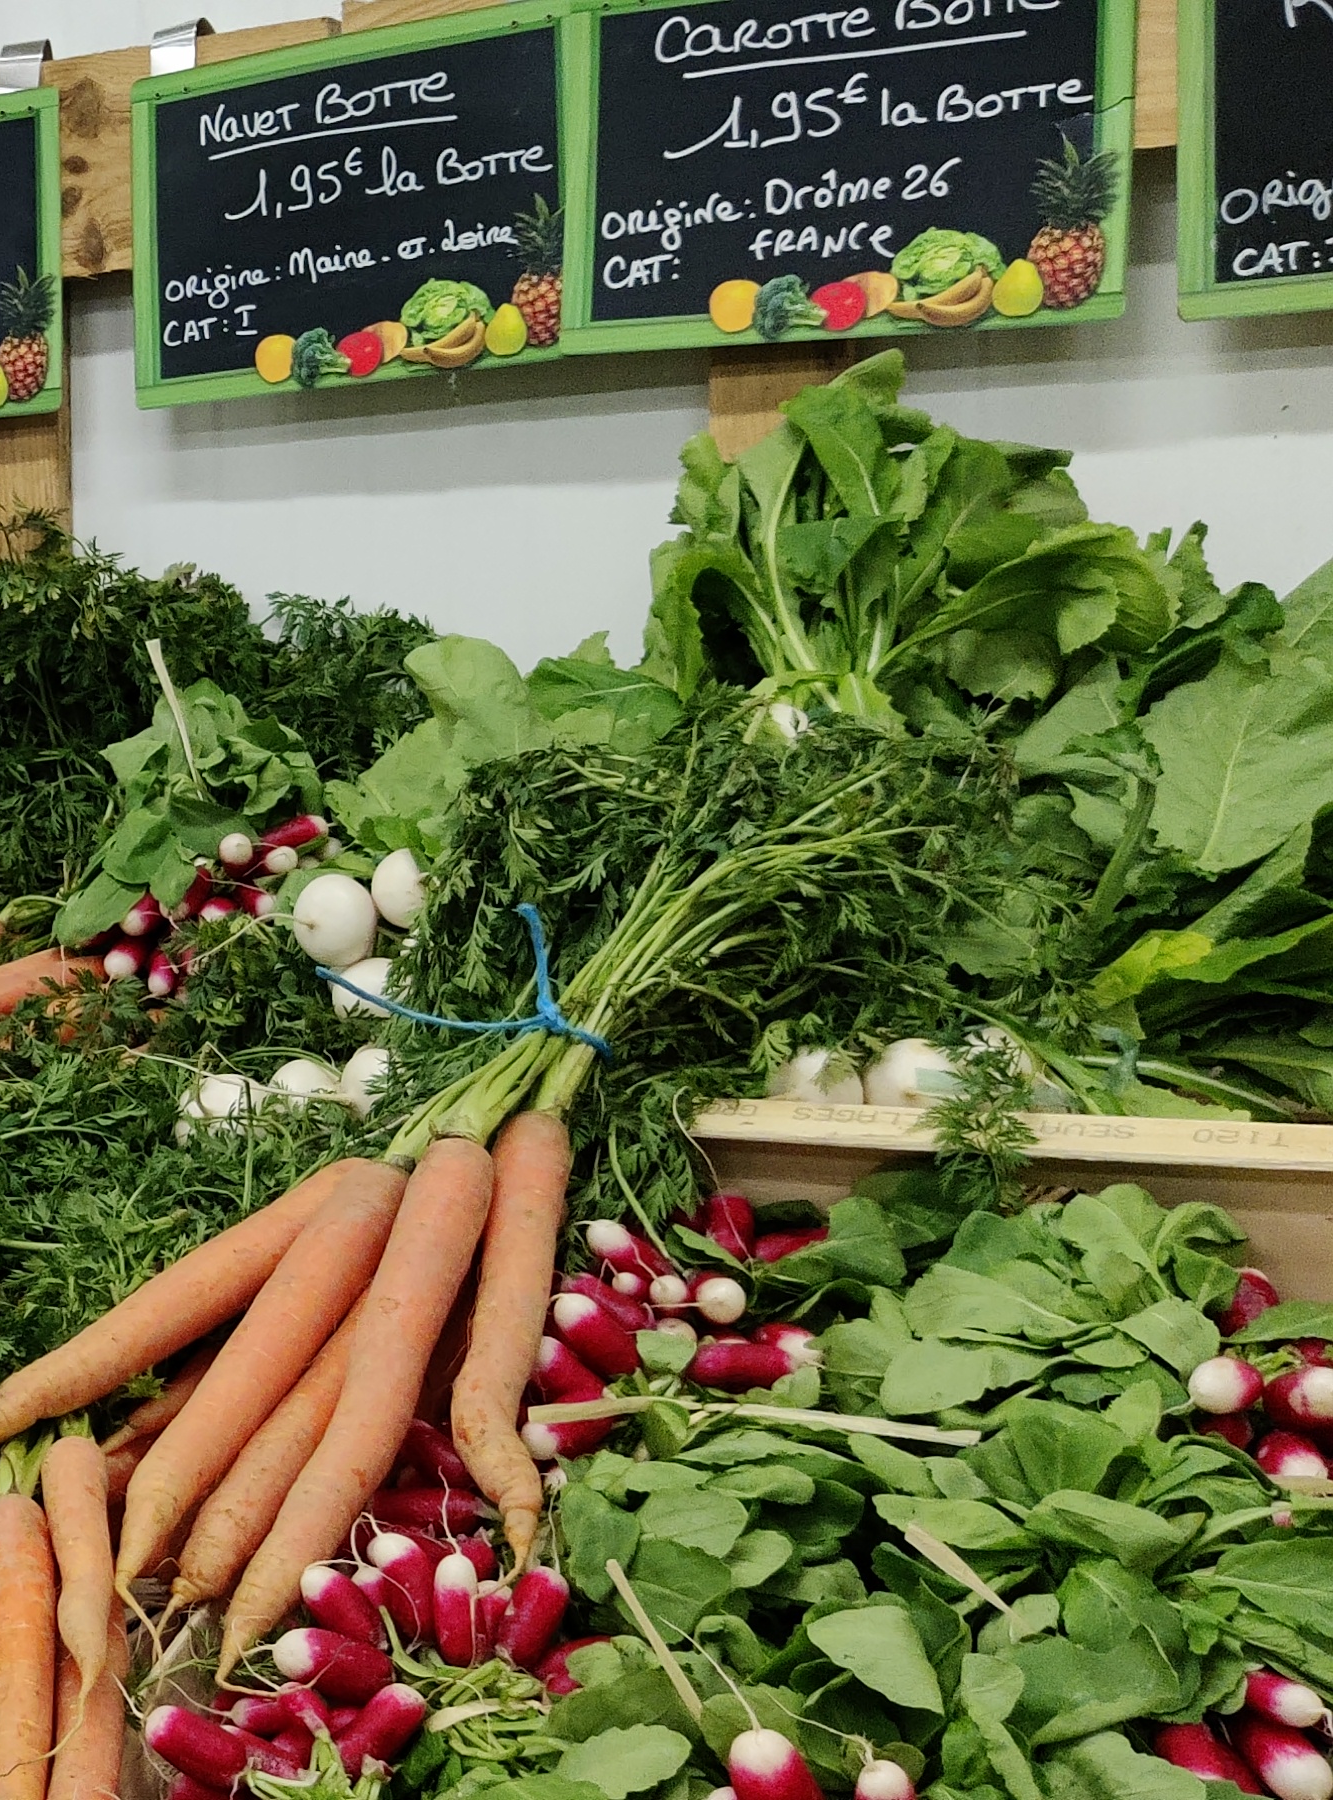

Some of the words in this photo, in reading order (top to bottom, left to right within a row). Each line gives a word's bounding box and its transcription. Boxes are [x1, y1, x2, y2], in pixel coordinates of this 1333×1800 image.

[881, 88, 928, 128] la
[365, 146, 424, 197] la
[764, 168, 891, 217] Drôme
[900, 157, 963, 200] 26
[1221, 170, 1333, 222] Orig
